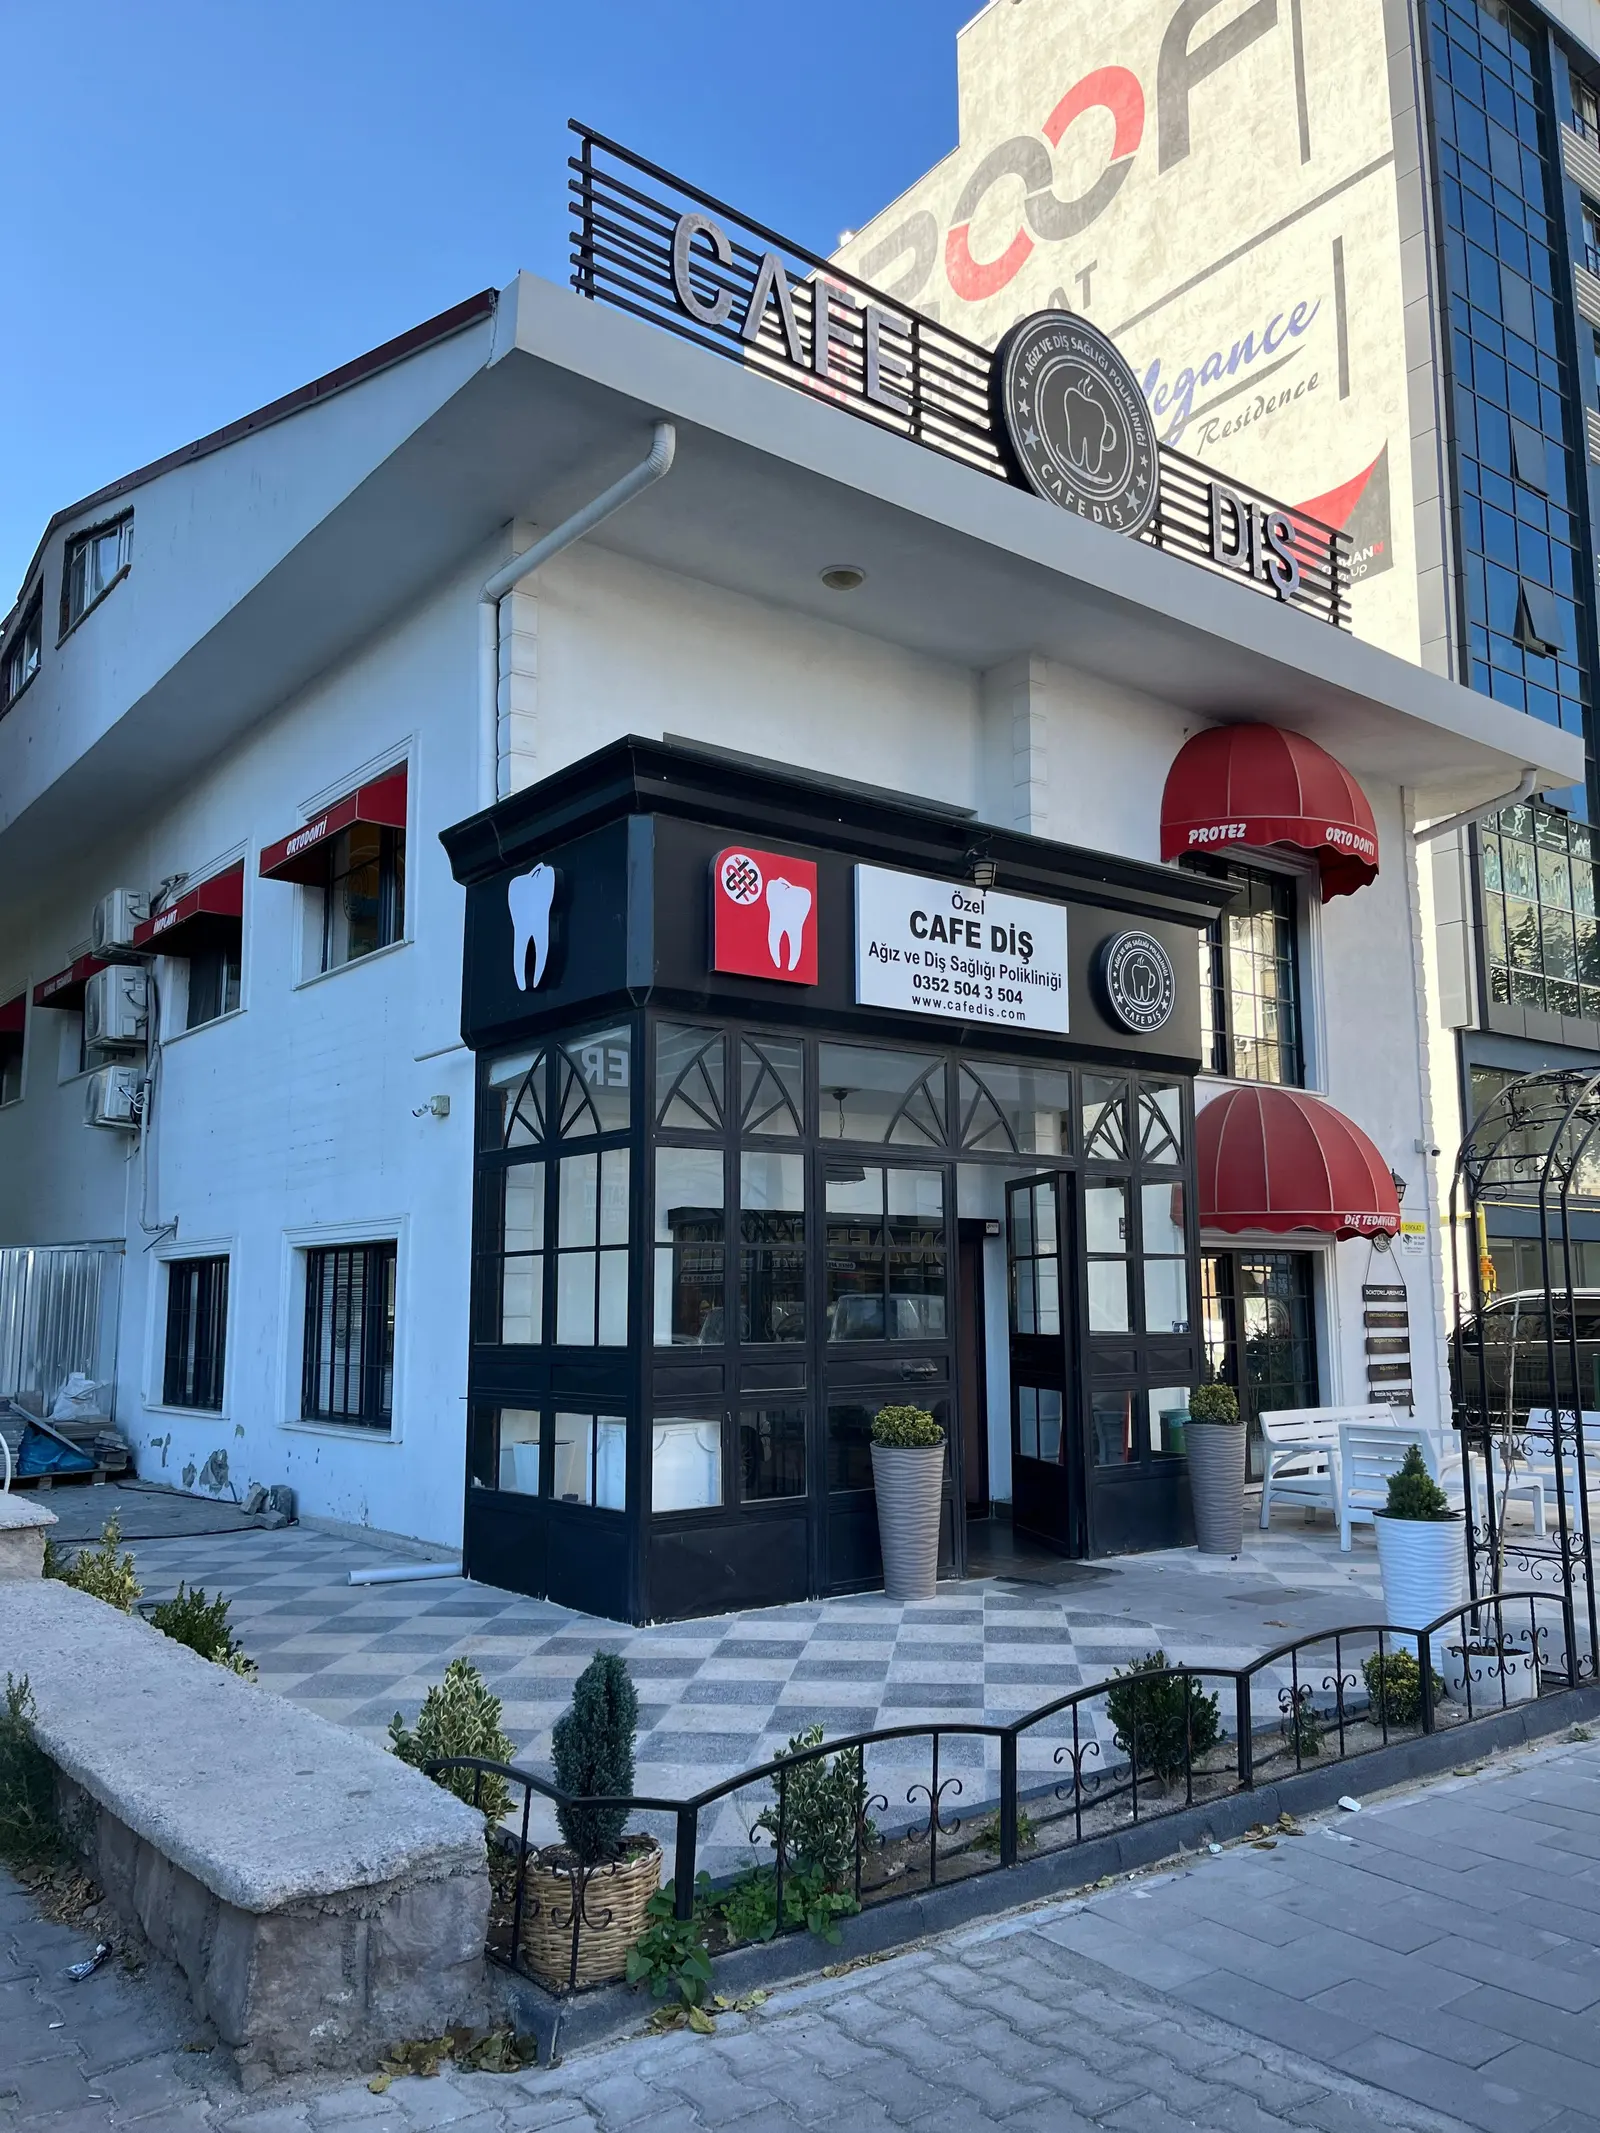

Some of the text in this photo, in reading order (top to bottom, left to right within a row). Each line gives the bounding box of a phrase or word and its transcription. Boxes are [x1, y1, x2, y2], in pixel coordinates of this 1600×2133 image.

[1024, 346, 1043, 376] AĞIZ
[1039, 337, 1053, 353] VE
[1052, 332, 1070, 351] DİŞ
[1070, 337, 1108, 370] SAĞLIĞI
[1132, 294, 1322, 448] legance
[674, 213, 909, 415] CAFE
[1212, 482, 1300, 601] DİŞ
[1197, 372, 1319, 456] Residence
[1041, 463, 1124, 526] CAFE DİŞ
[1188, 823, 1247, 844] PROTEZ
[951, 890, 985, 915] Özel
[909, 910, 1034, 964] CAFE DİŞ
[868, 941, 1062, 991] Ağız ve Diş Sağlığı Polikliniği
[913, 974, 1023, 1004] 0352 504 3 504
[912, 995, 1026, 1021] www.cafedis.com
